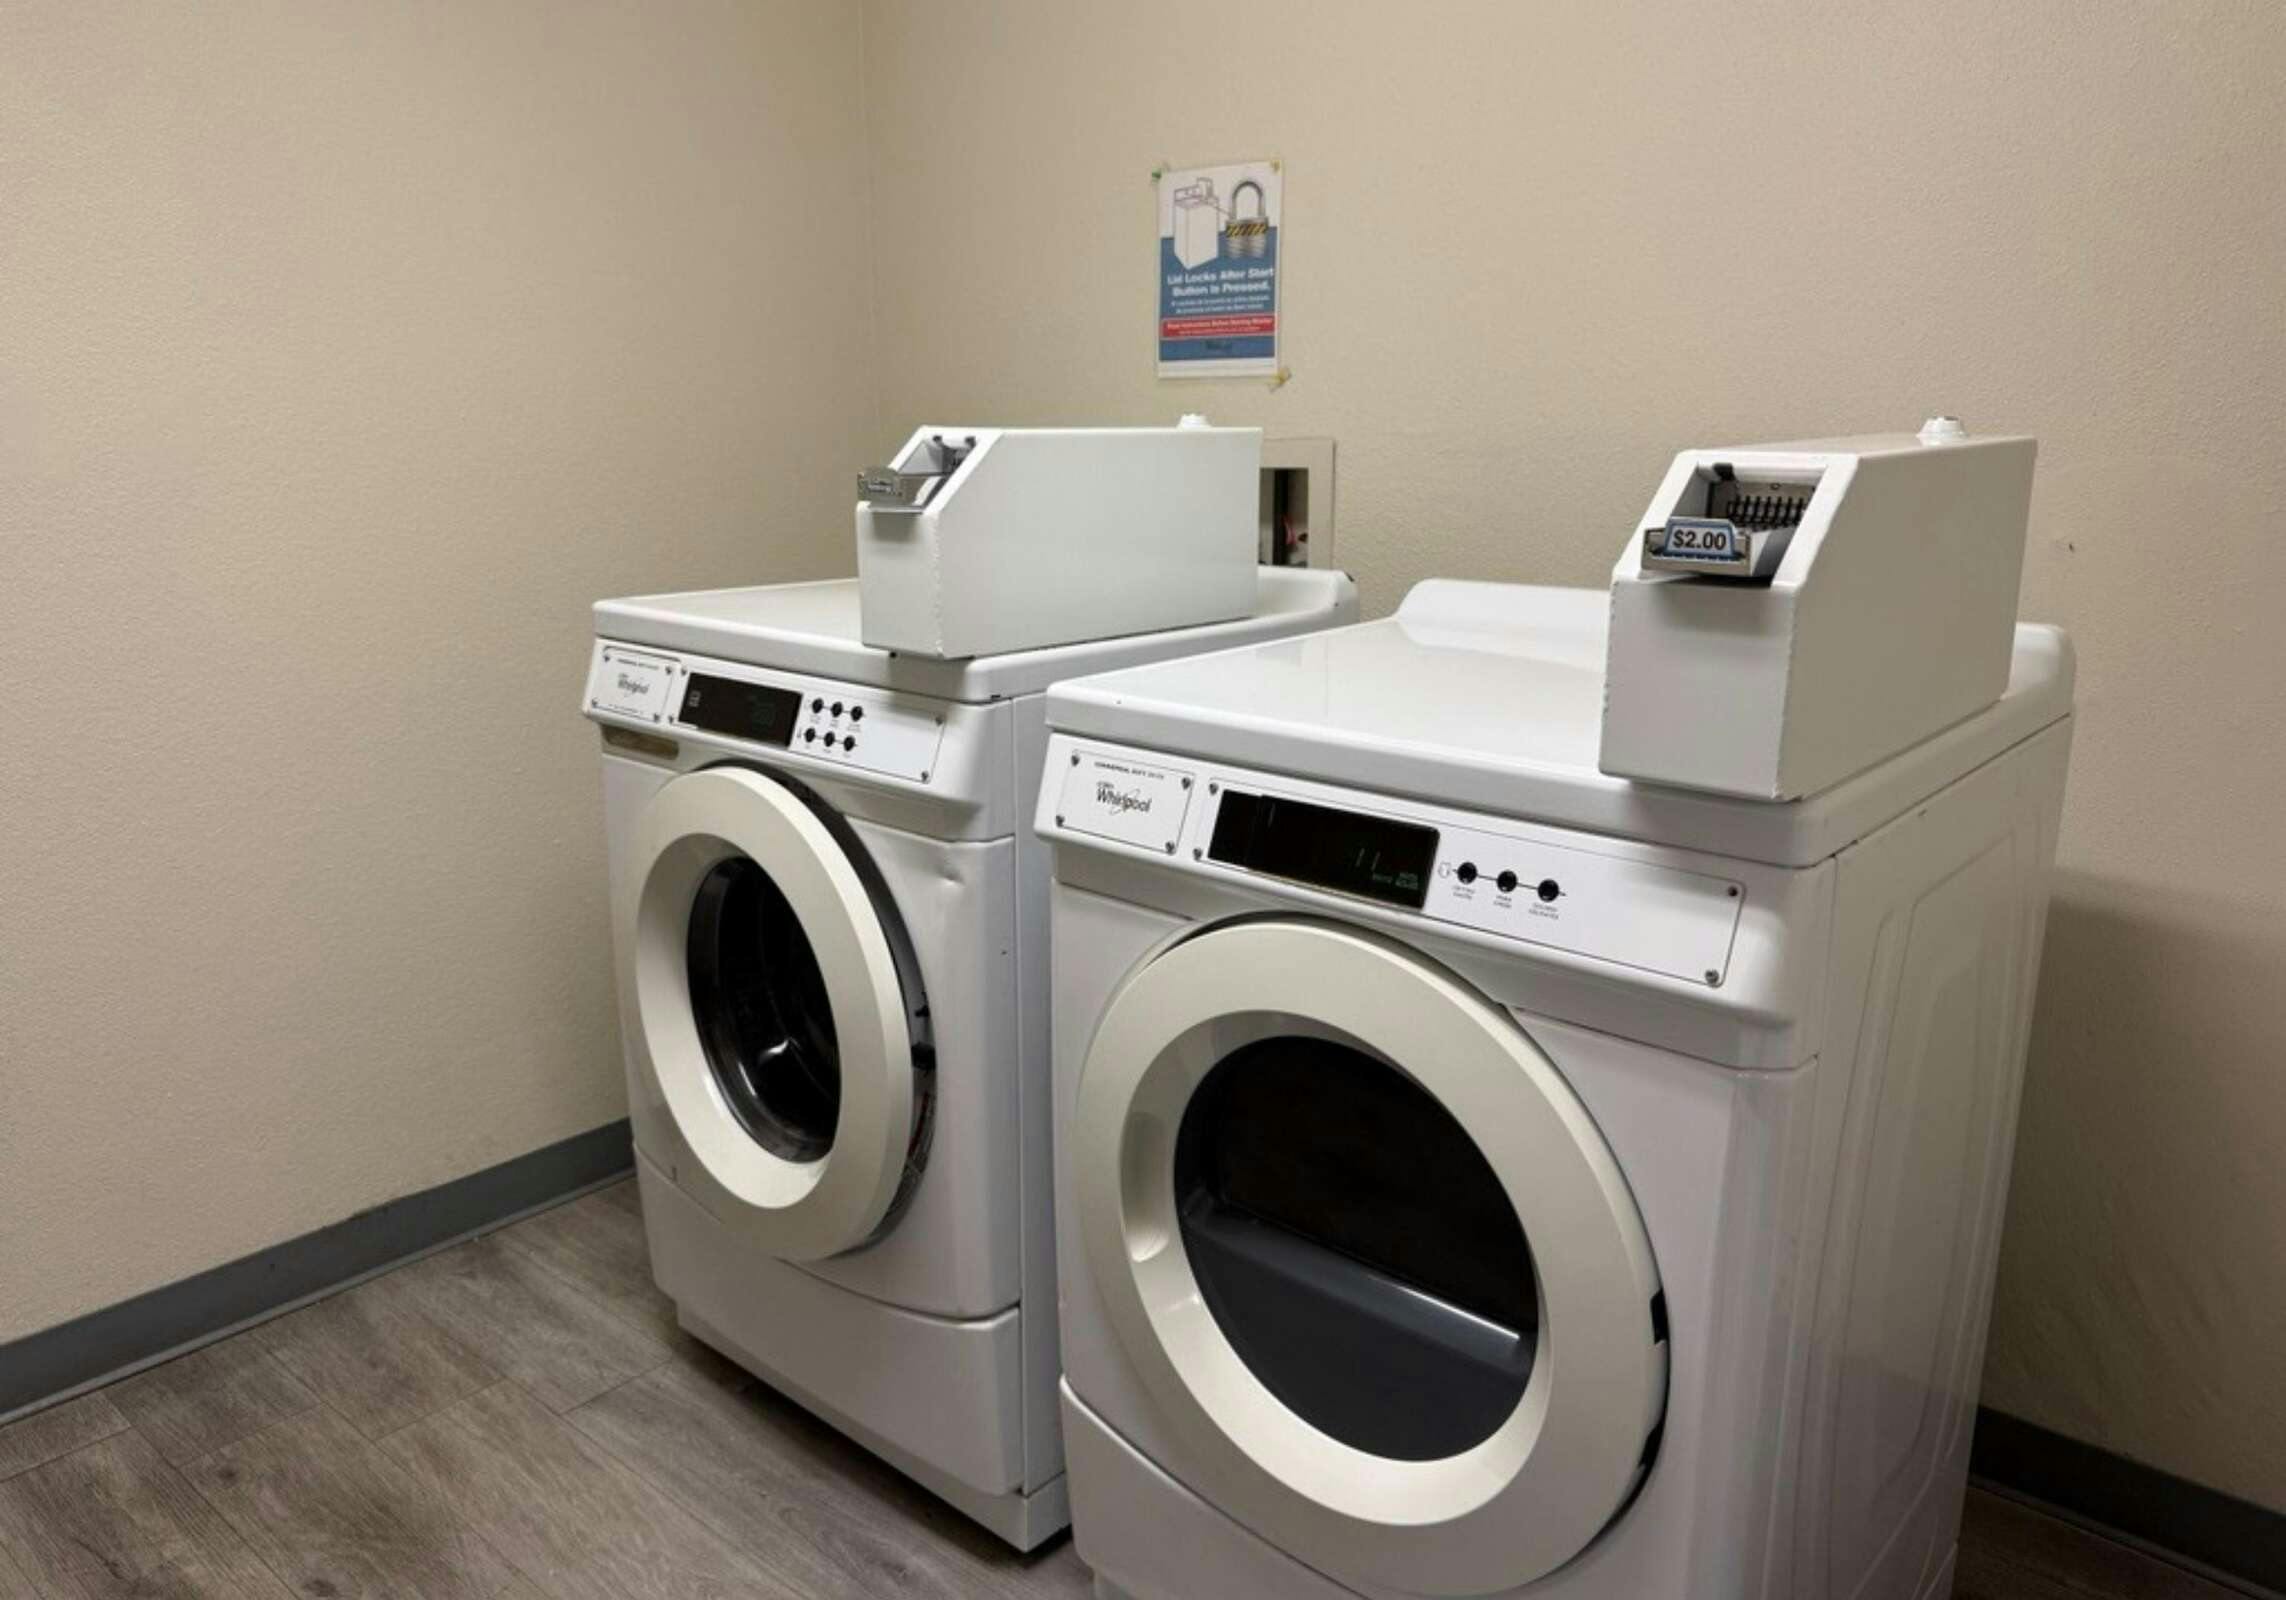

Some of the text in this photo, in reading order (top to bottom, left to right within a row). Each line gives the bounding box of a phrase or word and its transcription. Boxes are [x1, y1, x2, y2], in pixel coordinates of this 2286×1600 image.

[1185, 271, 1217, 283] Locks
[1172, 285, 1208, 297] Button
[1673, 529, 1726, 551] $2.00
[1096, 786, 1153, 813] Whirlpool
